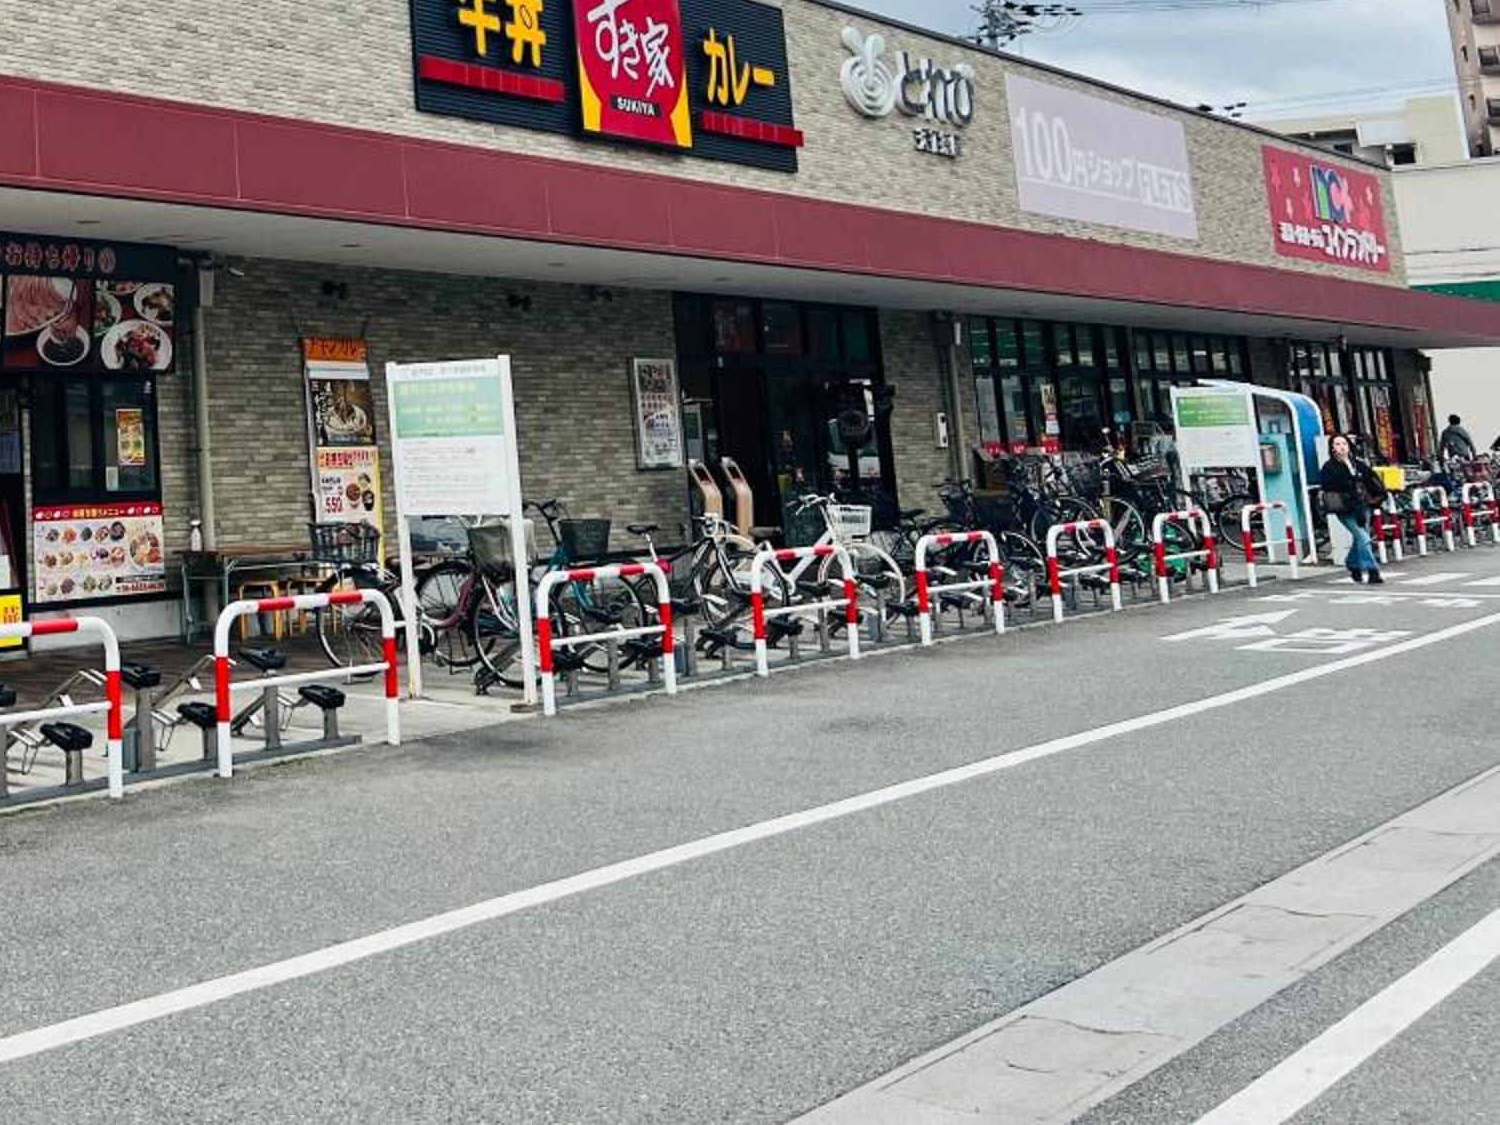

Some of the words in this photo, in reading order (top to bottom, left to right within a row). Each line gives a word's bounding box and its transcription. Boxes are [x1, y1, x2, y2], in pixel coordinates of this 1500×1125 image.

[702, 26, 775, 106] カレー
[616, 96, 656, 116] SUKIYA
